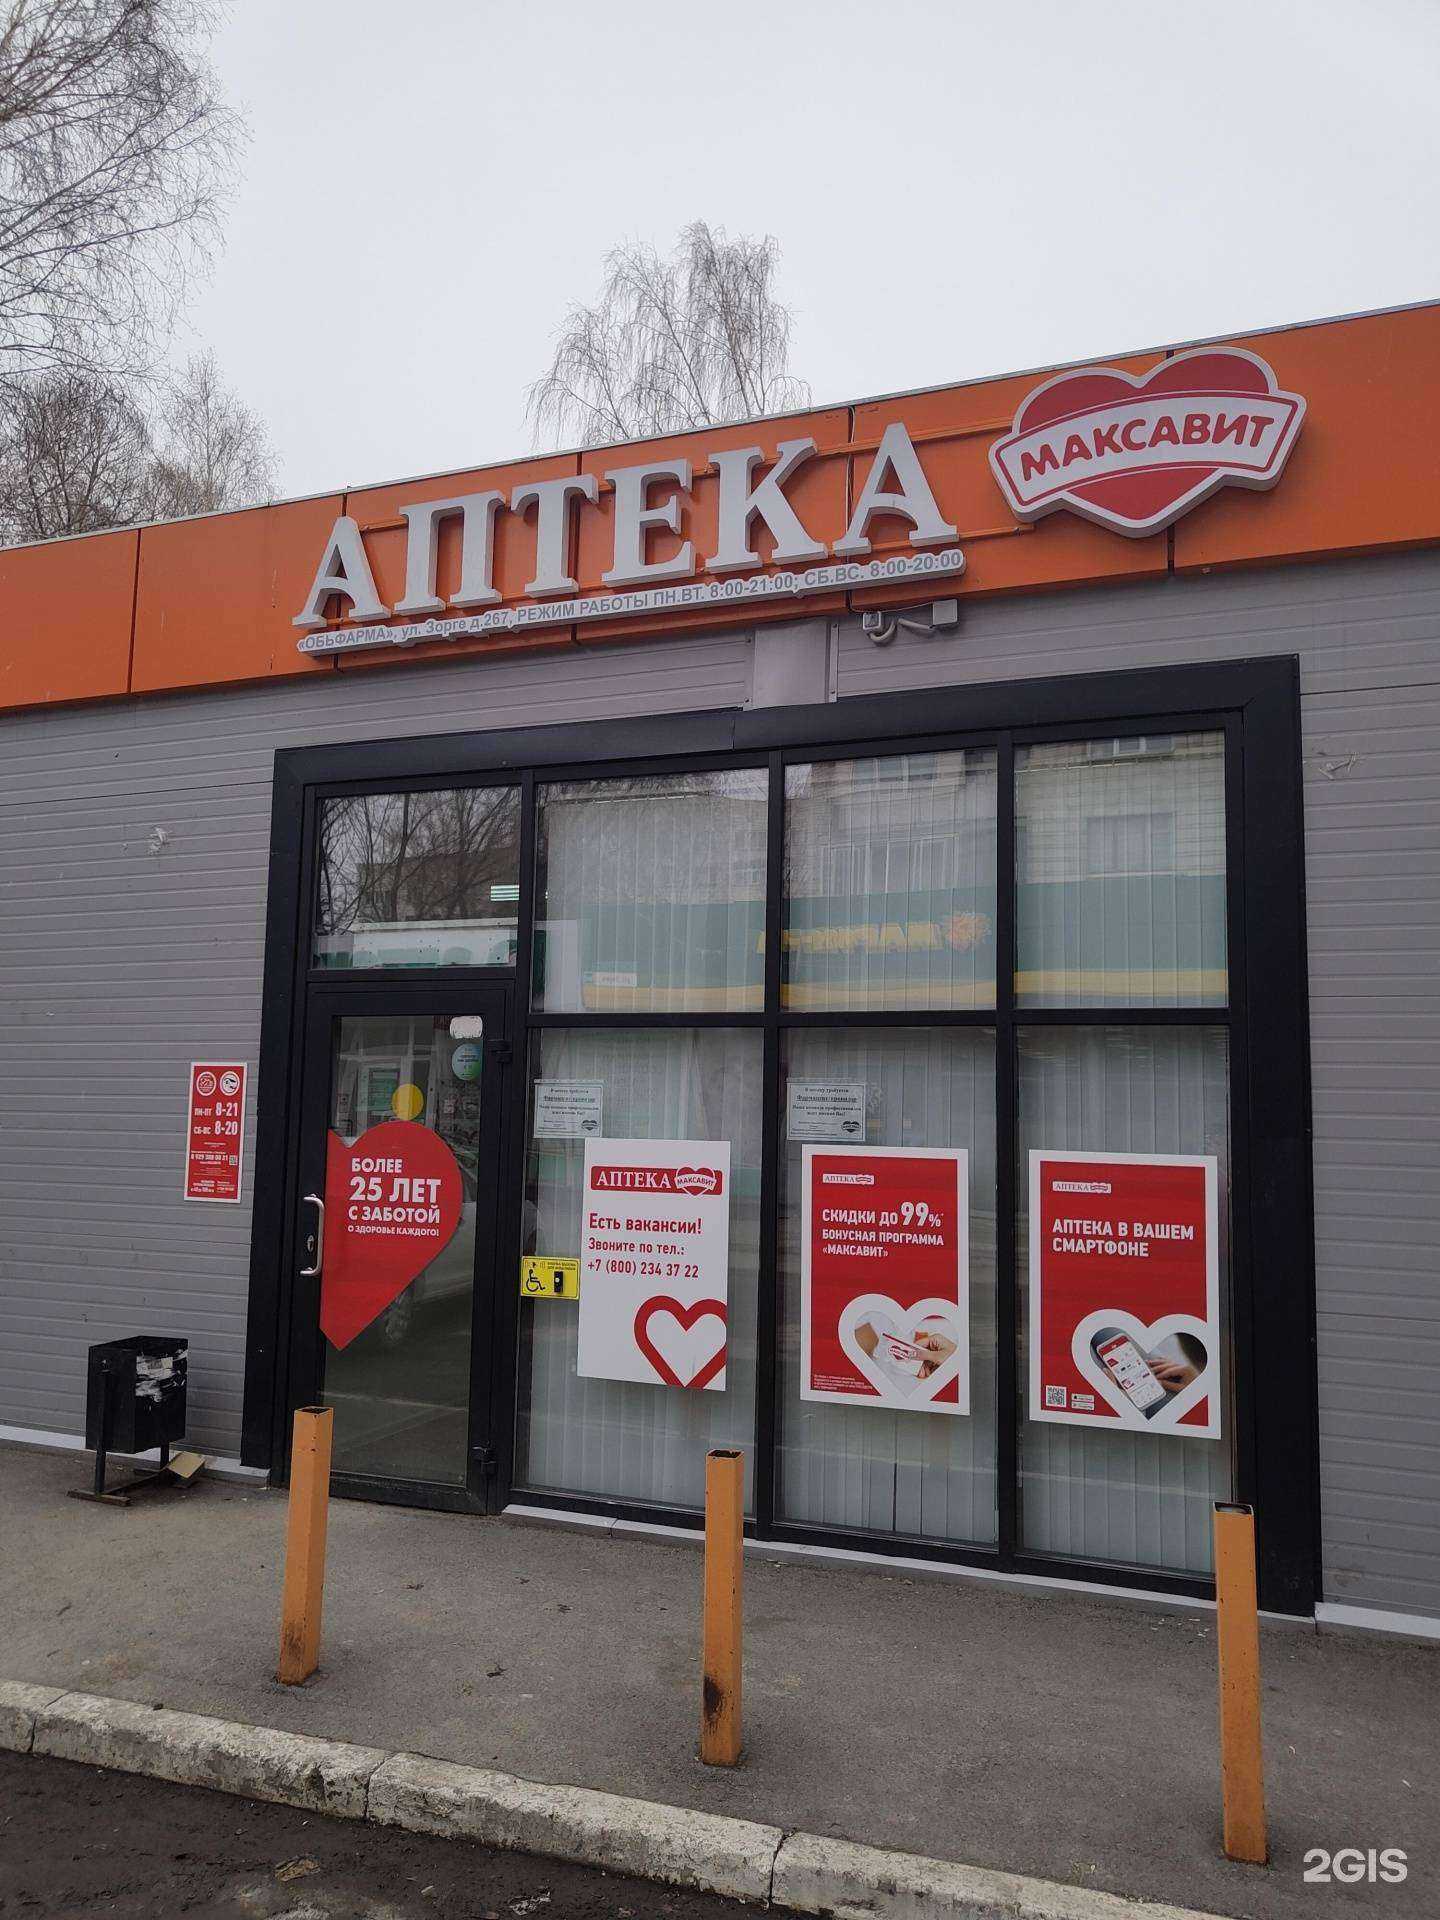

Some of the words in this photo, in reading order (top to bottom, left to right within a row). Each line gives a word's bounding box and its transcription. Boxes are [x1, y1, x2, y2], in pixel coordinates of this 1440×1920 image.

[1020, 413, 1275, 481] МАКСАВИТ
[292, 422, 958, 627] АПТЕКА
[401, 626, 421, 640] ул.
[426, 620, 466, 637] Зорге
[470, 611, 513, 630] д.267,
[517, 603, 575, 622] РЕЖИМ
[580, 594, 649, 614] РАБОТЫ
[710, 574, 799, 597] 8:00-21:00;
[804, 566, 865, 586] СБ.ВС.
[870, 551, 962, 578] 8:00-20:00
[215, 1102, 239, 1117] 8-21
[214, 1120, 238, 1136] 8-20
[351, 1157, 403, 1173] БОЛЕЕ
[596, 1170, 672, 1189] АПТЕКА
[677, 1175, 715, 1186] МАКСАВИТ
[350, 1176, 382, 1201] 25
[389, 1178, 441, 1203] ЛЕТ
[348, 1206, 358, 1220] С
[362, 1205, 440, 1224] ЗАБОТОЙ
[589, 1213, 621, 1230] Есть
[625, 1218, 702, 1234] вакансии!
[822, 1208, 875, 1225] СКИДКИ
[347, 1225, 354, 1233] О
[355, 1226, 395, 1236] ЗДОРОВЬЕ
[396, 1227, 440, 1237] КАЖДОГО!
[822, 1229, 876, 1242] БОНУСНАЯ
[879, 1232, 944, 1246] ПРОГРАММА
[1052, 1218, 1113, 1236] АПТЕКА
[1118, 1222, 1128, 1236] В
[1133, 1223, 1194, 1240] ВАШЕМ
[588, 1238, 635, 1252] Звоните
[639, 1243, 652, 1253] по
[657, 1244, 685, 1255] тел.:
[822, 1244, 889, 1258] «МАКСАВИТ»
[1052, 1237, 1149, 1257] СМАРТФОНЕ
[587, 1259, 601, 1272] +7
[606, 1260, 637, 1276] (800)
[641, 1262, 662, 1276] 234
[666, 1264, 680, 1277] 37
[684, 1265, 699, 1278] 22
